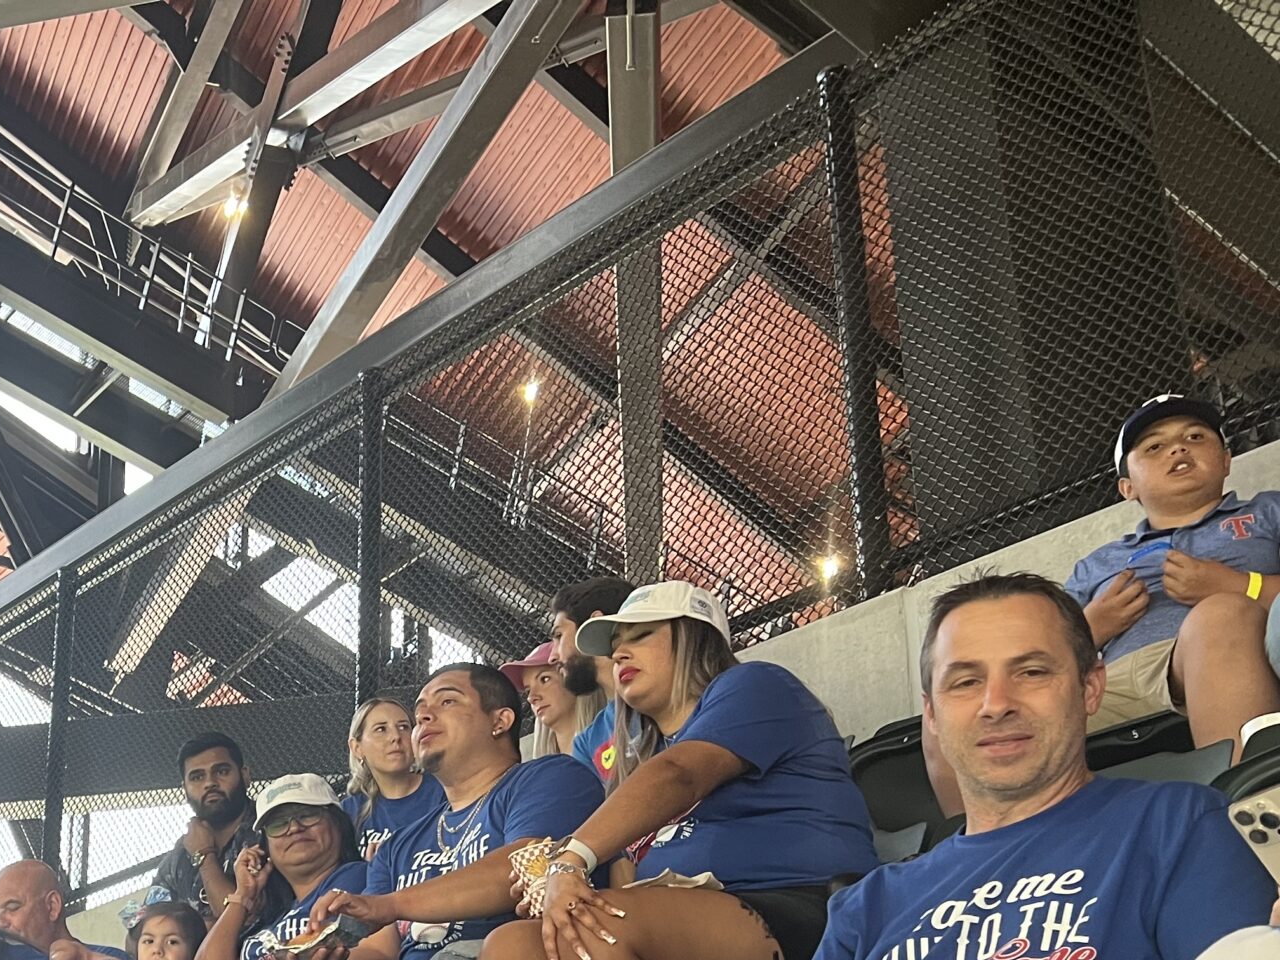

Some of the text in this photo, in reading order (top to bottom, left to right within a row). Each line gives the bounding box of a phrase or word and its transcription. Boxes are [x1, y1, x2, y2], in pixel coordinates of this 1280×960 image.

[1220, 514, 1255, 540] T
[1006, 869, 1085, 903] me
[1019, 897, 1098, 952] THE
